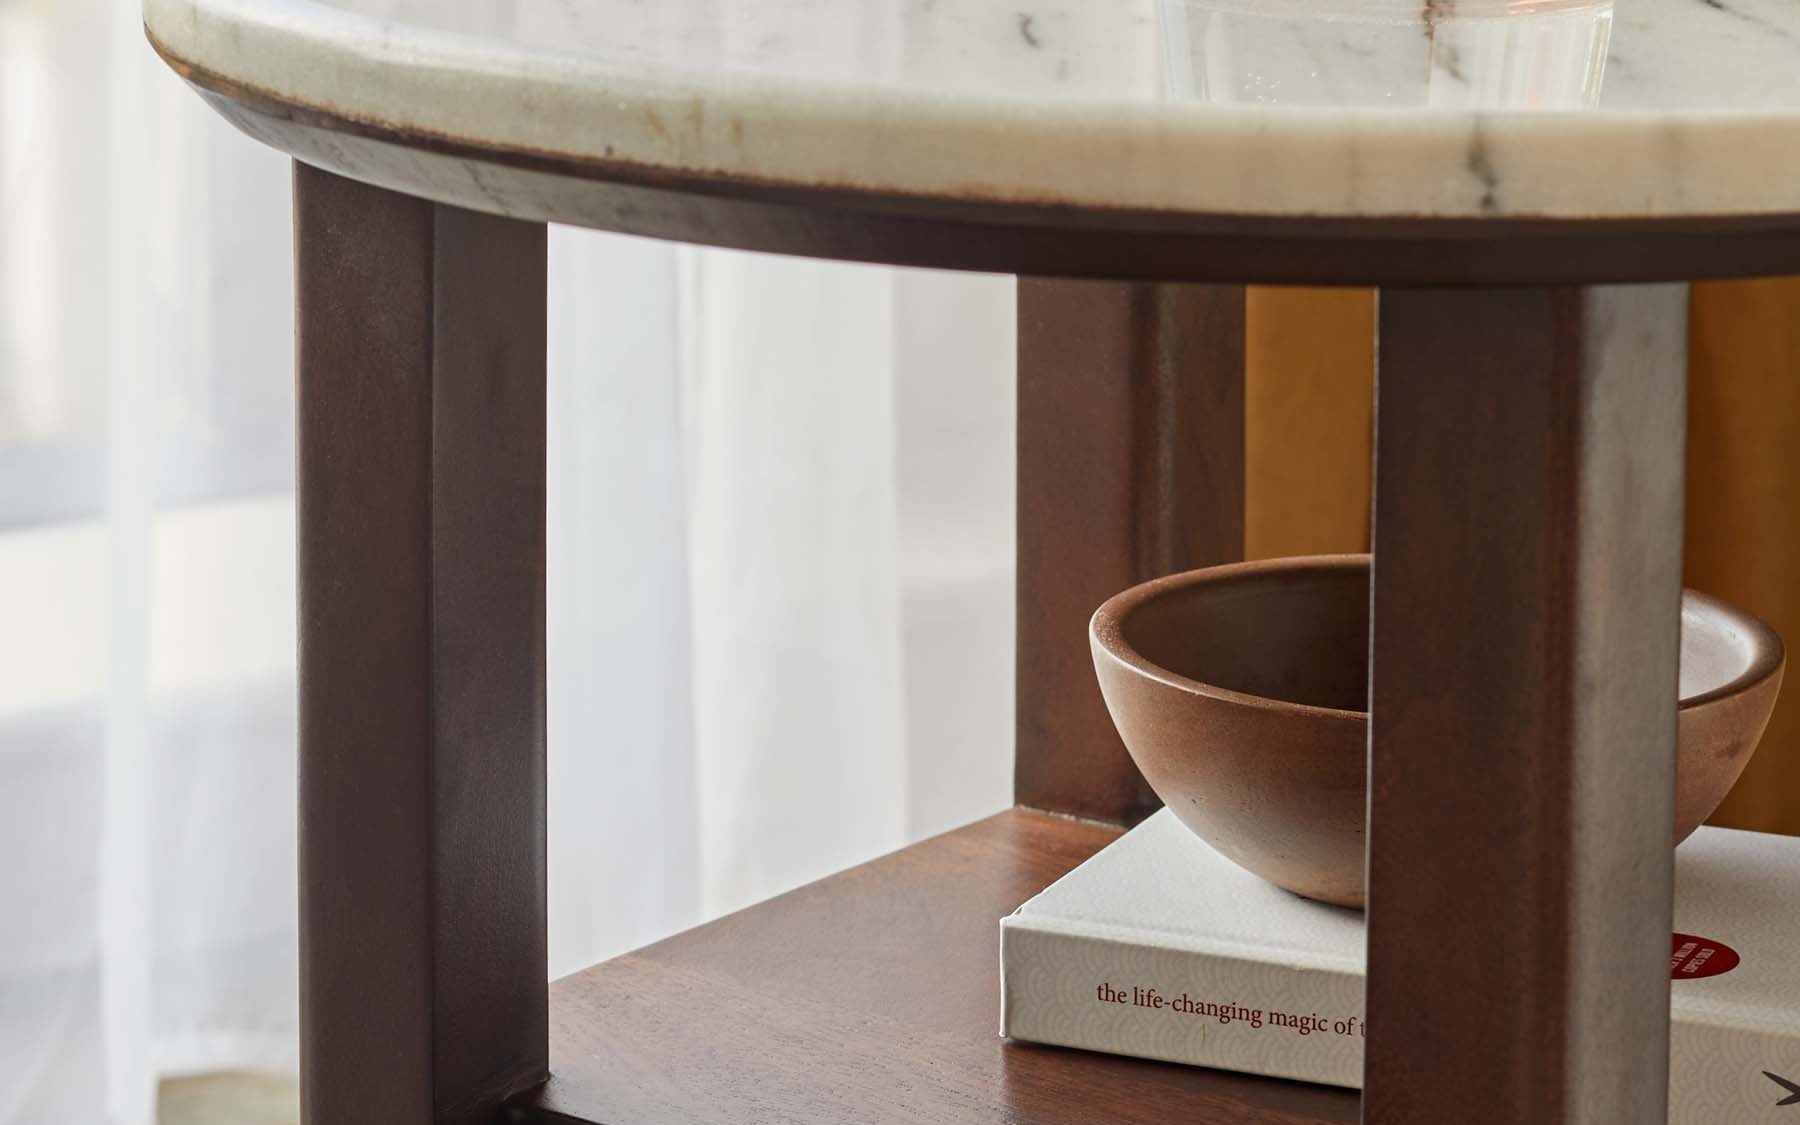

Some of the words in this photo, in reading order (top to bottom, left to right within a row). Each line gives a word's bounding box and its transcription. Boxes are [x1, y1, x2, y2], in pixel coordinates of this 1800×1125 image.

[1681, 957, 1706, 973] COPIES
[1695, 948, 1716, 960] SOLD
[1096, 982, 1127, 1004] the
[1133, 986, 1263, 1029] life-changing
[1268, 1012, 1328, 1036] magic
[1334, 1016, 1357, 1036] of
